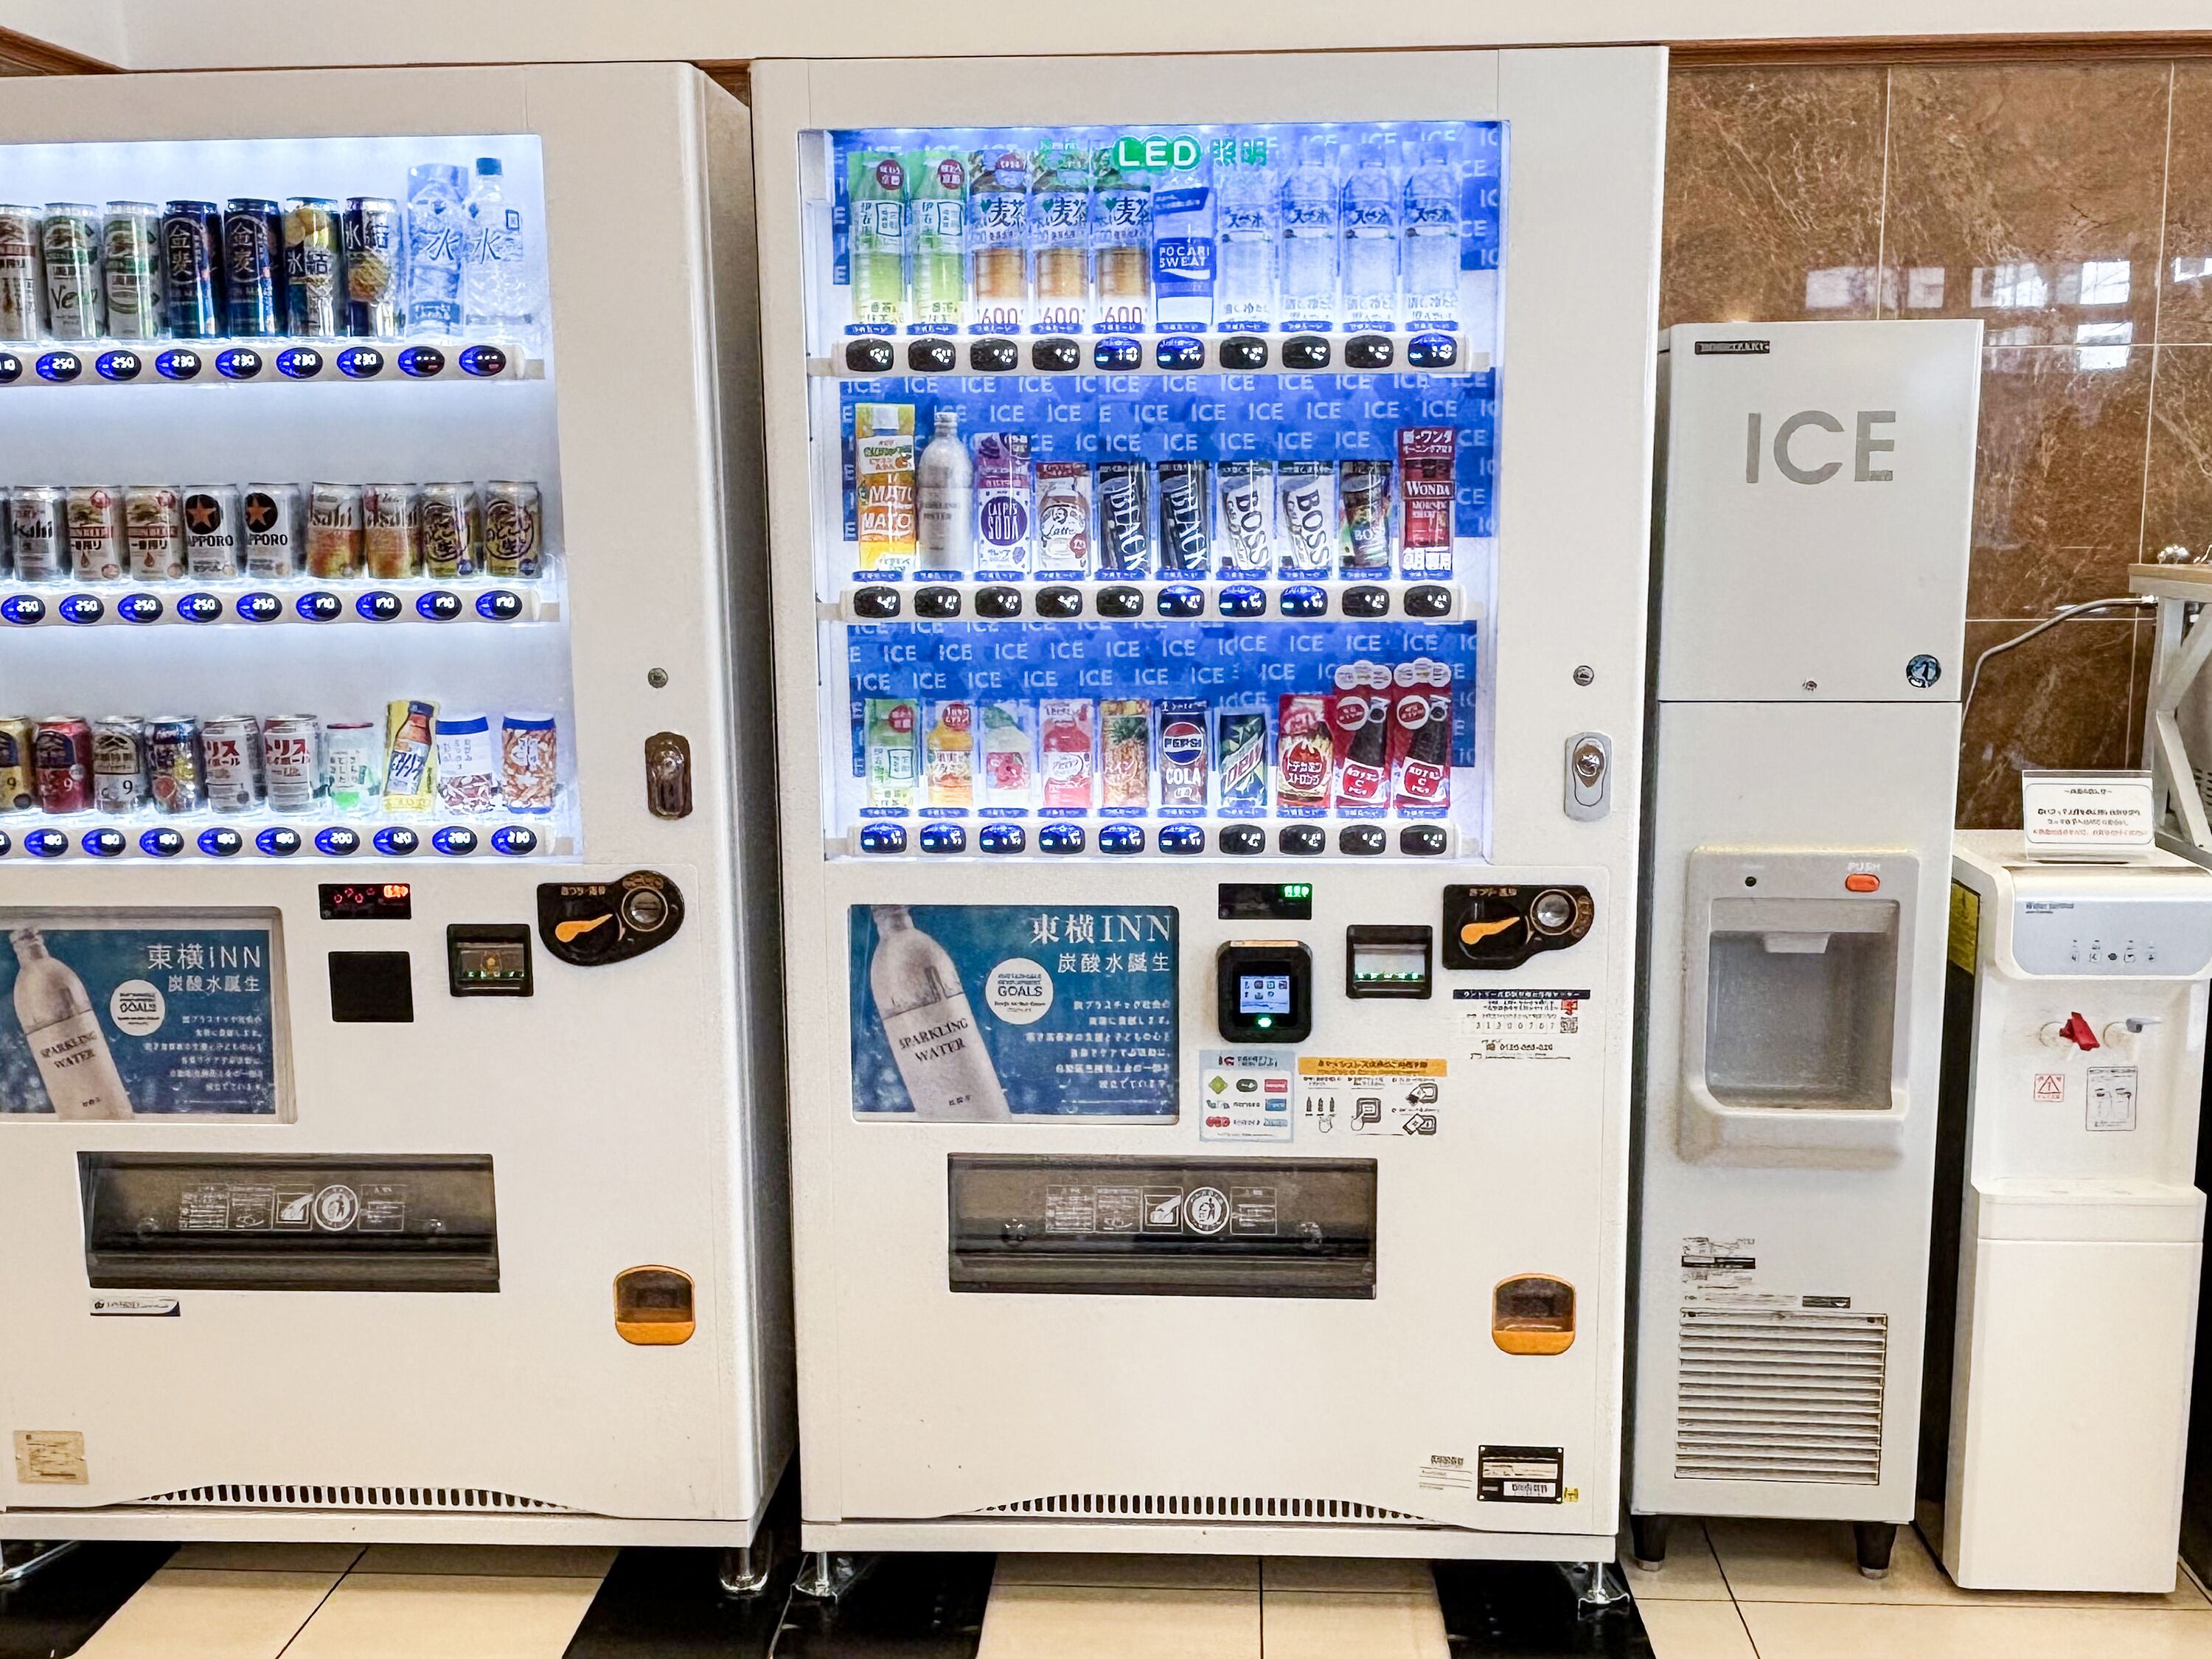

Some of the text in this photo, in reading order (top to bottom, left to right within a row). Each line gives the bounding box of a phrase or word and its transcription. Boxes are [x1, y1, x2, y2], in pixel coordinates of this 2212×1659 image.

[1119, 140, 1198, 167] LED
[988, 197, 1025, 227] 麦茶
[425, 227, 454, 261] 水
[472, 227, 502, 264] 水
[1159, 246, 1210, 257] POCARI
[1159, 256, 1206, 268] SWEAT
[990, 404, 1024, 422] ICE
[1048, 403, 1081, 422] ICE
[1135, 404, 1168, 422] ICE
[1191, 403, 1226, 422] ICE
[1249, 403, 1284, 422] ICE
[1307, 402, 1341, 421] ICE
[1364, 400, 1399, 420] ICE
[1422, 400, 1457, 418] ICE
[1106, 434, 1141, 452] ICE
[1164, 433, 1198, 452] ICE
[1220, 432, 1256, 451] ICE
[1278, 431, 1312, 450] ICE
[1335, 431, 1370, 450] ICE
[1746, 410, 1896, 485] ICE
[1406, 481, 1450, 496] WONDA
[988, 515, 1019, 540] SODA
[1110, 476, 1149, 577] BLACK
[1171, 476, 1209, 569] BLACK
[1235, 490, 1269, 565] BOSS
[1296, 489, 1329, 565] BOSS
[188, 535, 234, 547] APPORO
[248, 534, 288, 546] PPORO
[995, 643, 1029, 660] ICE
[1051, 642, 1084, 659] ICE
[1106, 641, 1140, 658] ICE
[1162, 639, 1196, 657] ICE
[1234, 636, 1267, 653] ICE
[1290, 635, 1324, 653] ICE
[1346, 634, 1381, 652] ICE
[1403, 634, 1437, 651] ICE
[884, 644, 917, 662] ICE
[939, 644, 973, 661] ICE
[856, 673, 890, 690] ICE
[913, 673, 946, 689] ICE
[968, 672, 1002, 689] ICE
[1024, 671, 1058, 687] ICE
[1079, 669, 1113, 686] ICE
[1135, 668, 1168, 686] ICE
[1191, 667, 1224, 684] ICE
[1262, 664, 1295, 681] ICE
[206, 740, 240, 757] リス
[1164, 737, 1202, 748] PEPSI
[7, 777, 16, 790] 9
[63, 779, 73, 791] 9
[1166, 767, 1202, 786] COLA
[122, 779, 133, 796] 9
[1029, 913, 1172, 945] 東横INN
[147, 942, 261, 970] 東横INN
[1057, 952, 1171, 974] 炭酸水誕生
[168, 974, 260, 993] 炭酸水誕生
[998, 986, 1043, 997] GOALS
[899, 1018, 968, 1051] SPARKLING
[54, 1048, 96, 1069] WATER
[915, 1037, 966, 1063] WATER
